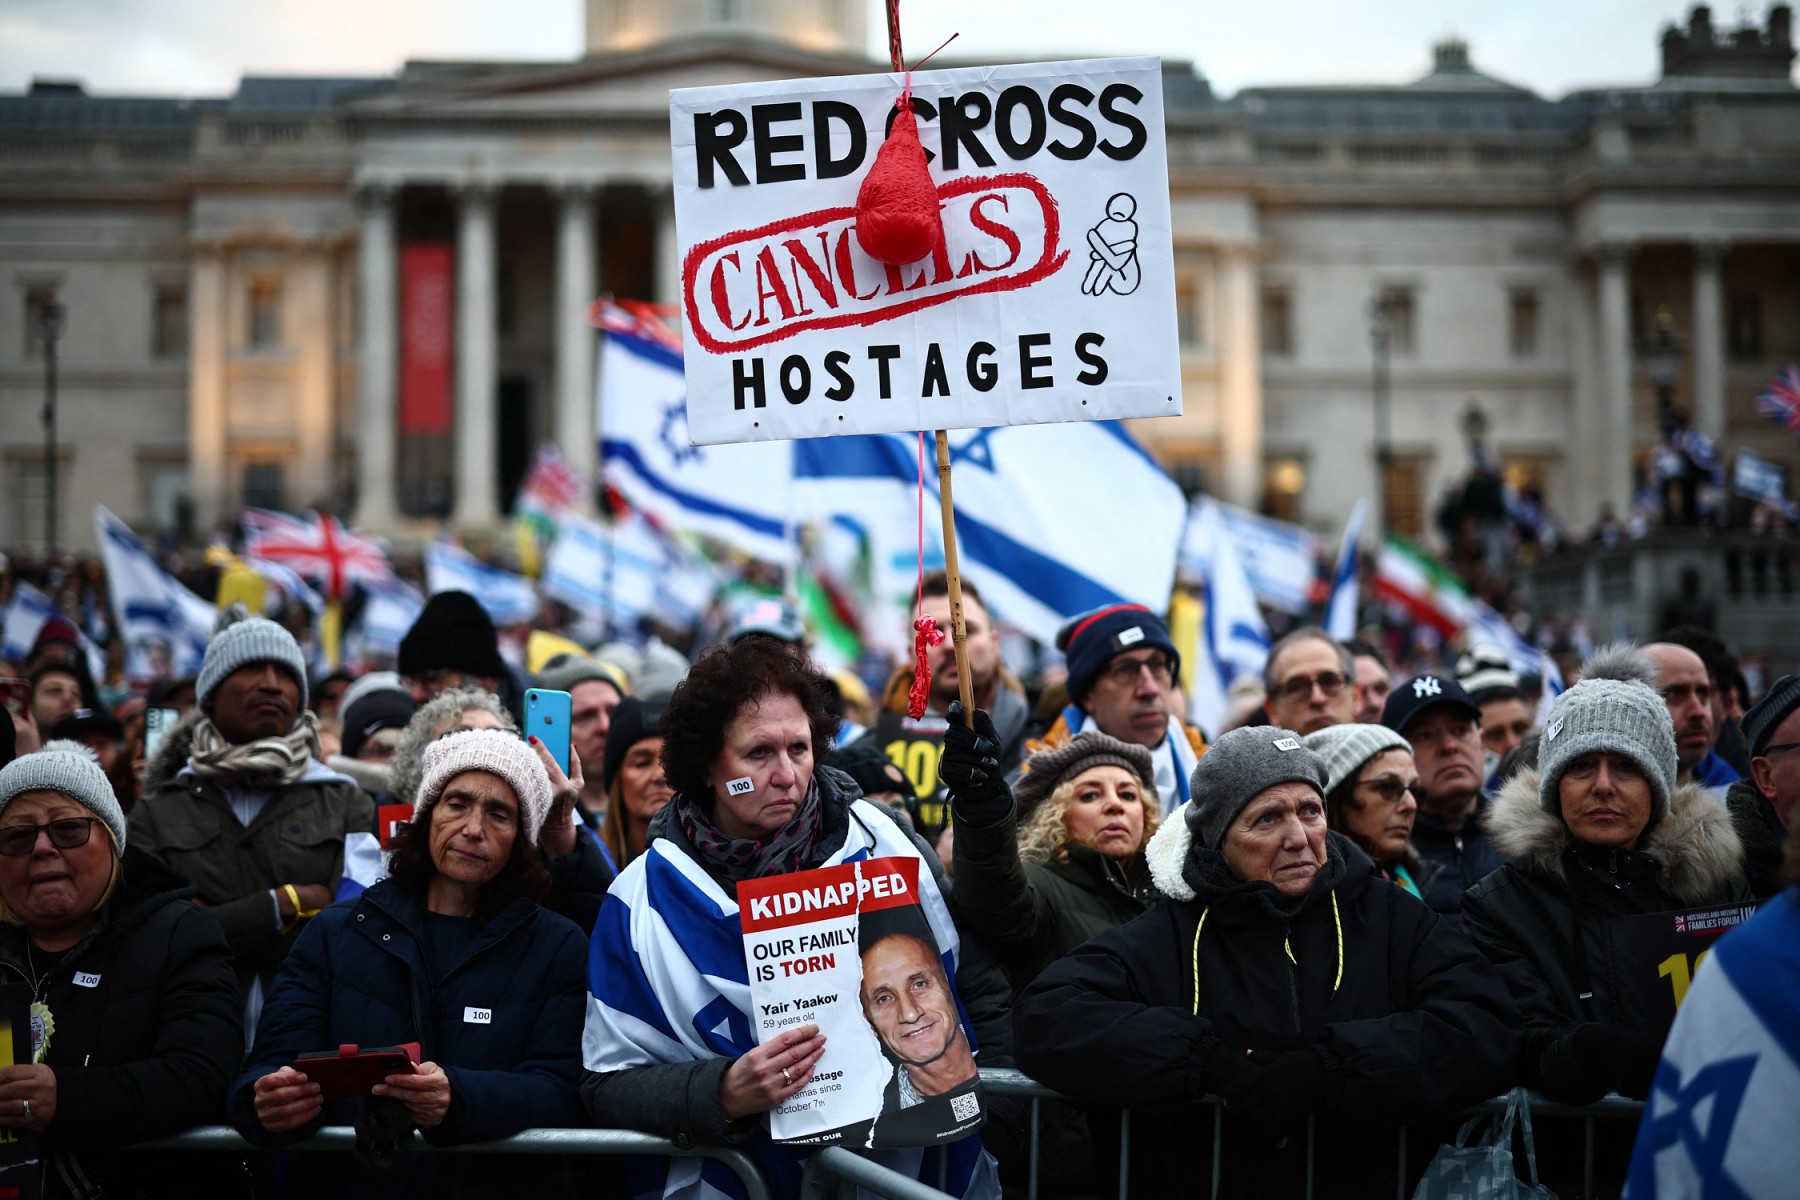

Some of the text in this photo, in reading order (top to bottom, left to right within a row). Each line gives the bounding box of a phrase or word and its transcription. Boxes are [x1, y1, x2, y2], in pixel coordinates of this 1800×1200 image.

[694, 101, 867, 188] RED
[732, 332, 1109, 410] HOSTAGES
[1413, 676, 1442, 698] NY
[1281, 740, 1296, 748] 100
[732, 781, 750, 792] 100
[750, 873, 908, 921] KIDNAPPED
[1688, 915, 1740, 931] FAMILIES FORUM
[753, 926, 857, 961] OUR FAMILY
[756, 953, 836, 982] IS TORN
[80, 975, 98, 985] 100
[761, 993, 839, 1016] Yair Yaakov
[473, 1011, 490, 1020] 100
[763, 1011, 815, 1030] 59 years old
[819, 1083, 842, 1094] since
[776, 1101, 812, 1115] October
[813, 1099, 826, 1108] 7th
[822, 1132, 843, 1141] OUR
